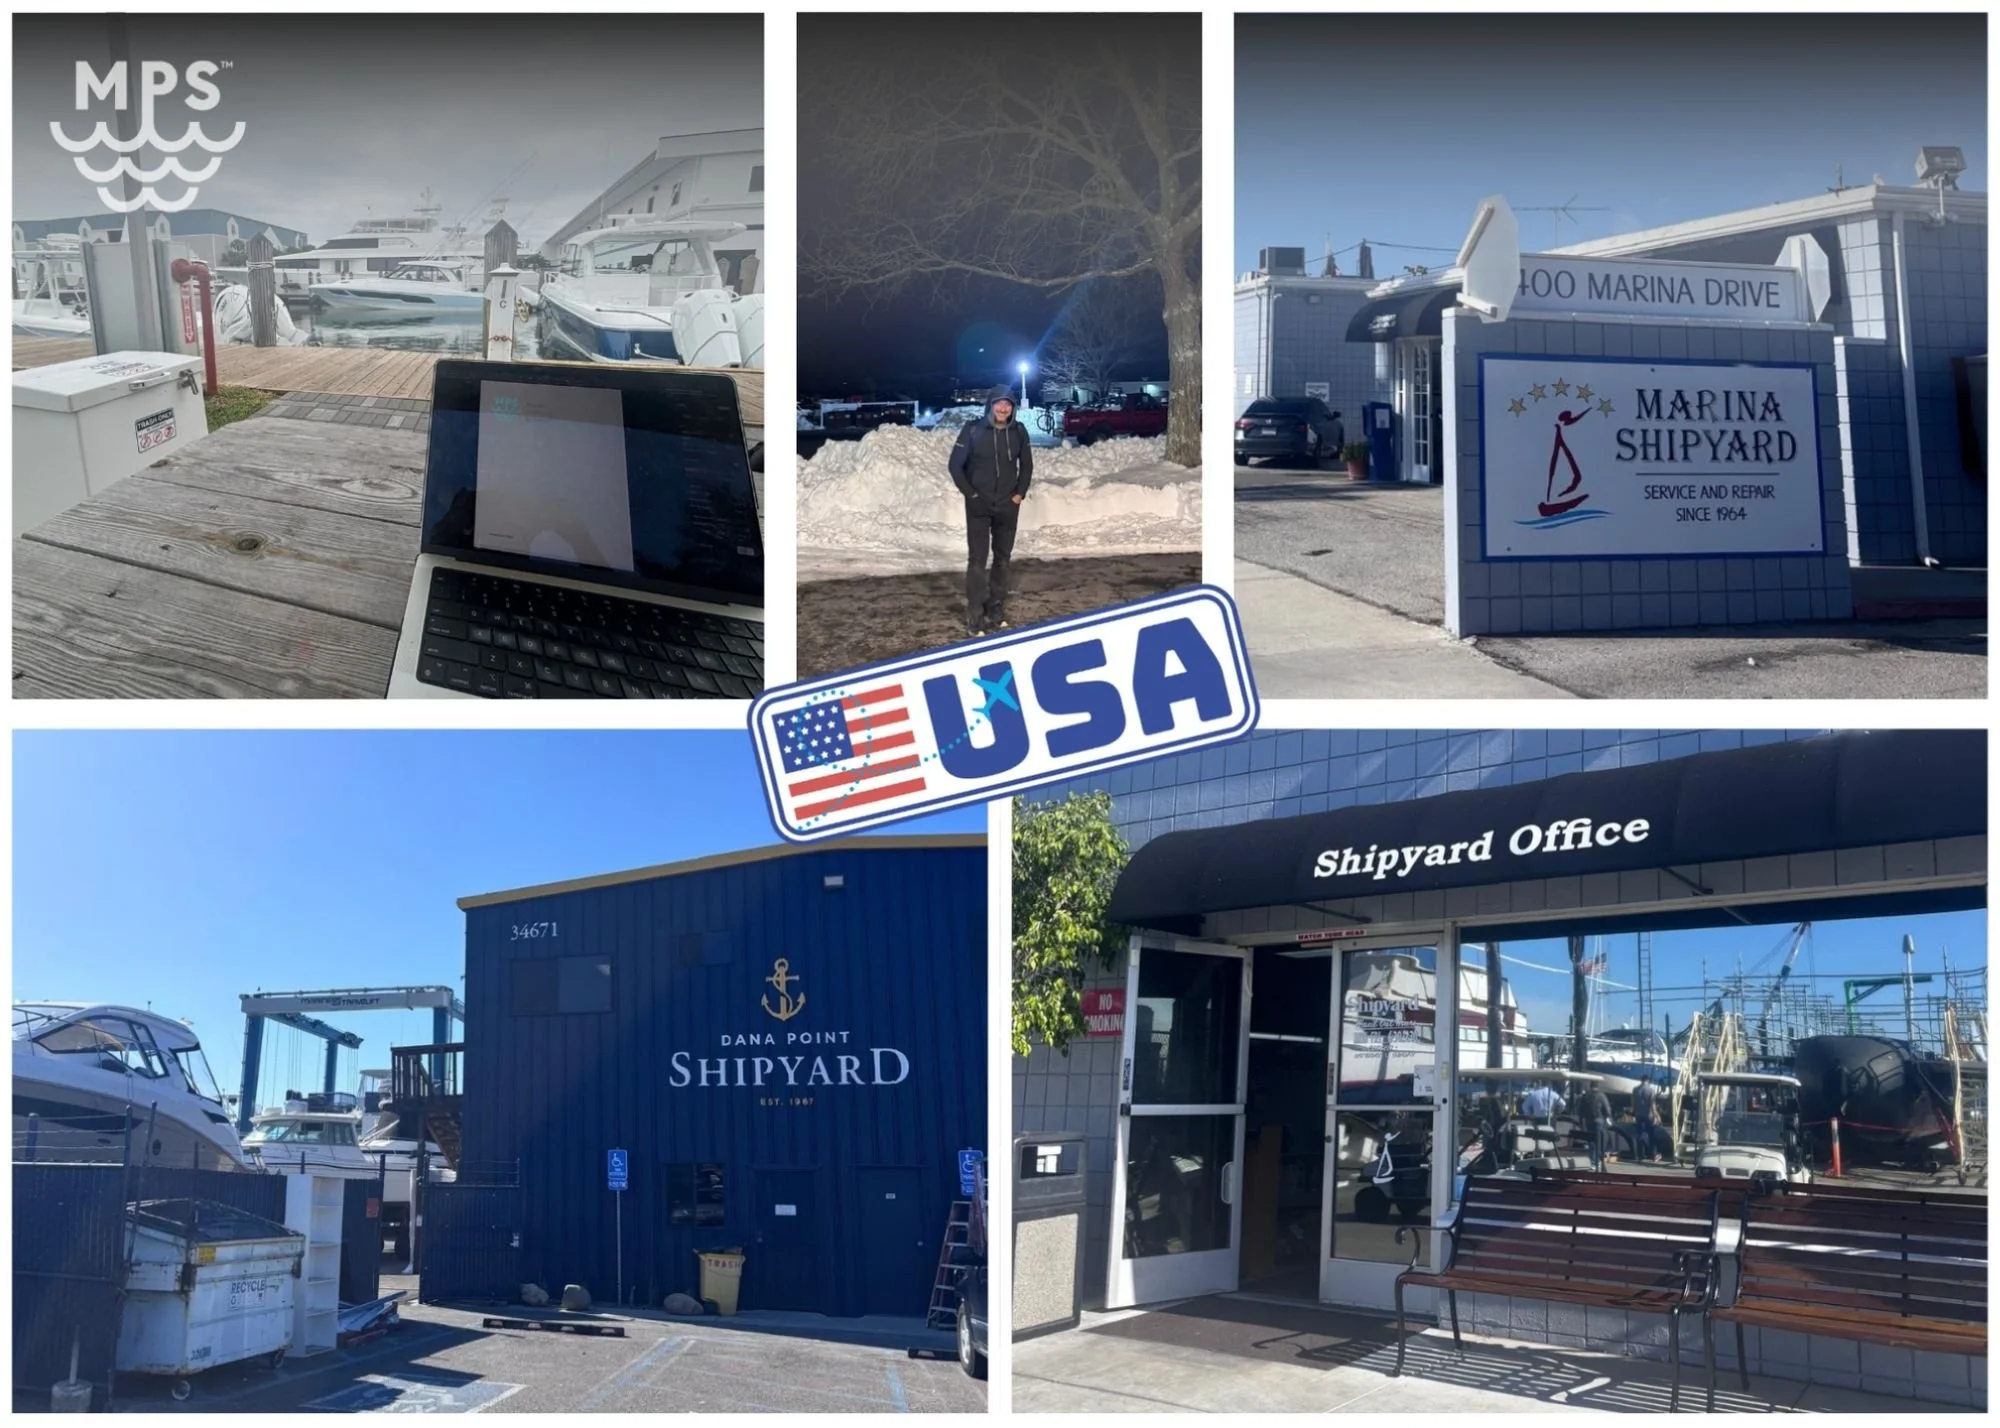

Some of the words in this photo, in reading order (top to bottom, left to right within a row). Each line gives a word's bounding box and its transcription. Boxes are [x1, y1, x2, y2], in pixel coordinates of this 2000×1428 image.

[1588, 272, 1695, 305] MARINA
[1704, 278, 1781, 308] DRIVE
[1635, 387, 1785, 422] MARINA
[1615, 427, 1798, 465] SHIPYARD
[1644, 484, 1697, 500] SERVICE
[1700, 484, 1729, 500] AND
[1731, 484, 1776, 500] REPAIR
[1675, 507, 1711, 522] SINCE
[1716, 506, 1748, 521] 1964
[1313, 830, 1495, 880] Shipyard
[1509, 817, 1651, 856] Office
[510, 920, 559, 941] 34671
[1099, 993, 1113, 1010] NO
[1346, 993, 1420, 1017] Shipyard
[721, 1033, 776, 1046] DANA
[787, 1031, 851, 1045] POINT
[669, 1047, 910, 1088] SHIPYARD
[708, 1258, 741, 1269] TRASH
[231, 1279, 265, 1294] RECYCLE
